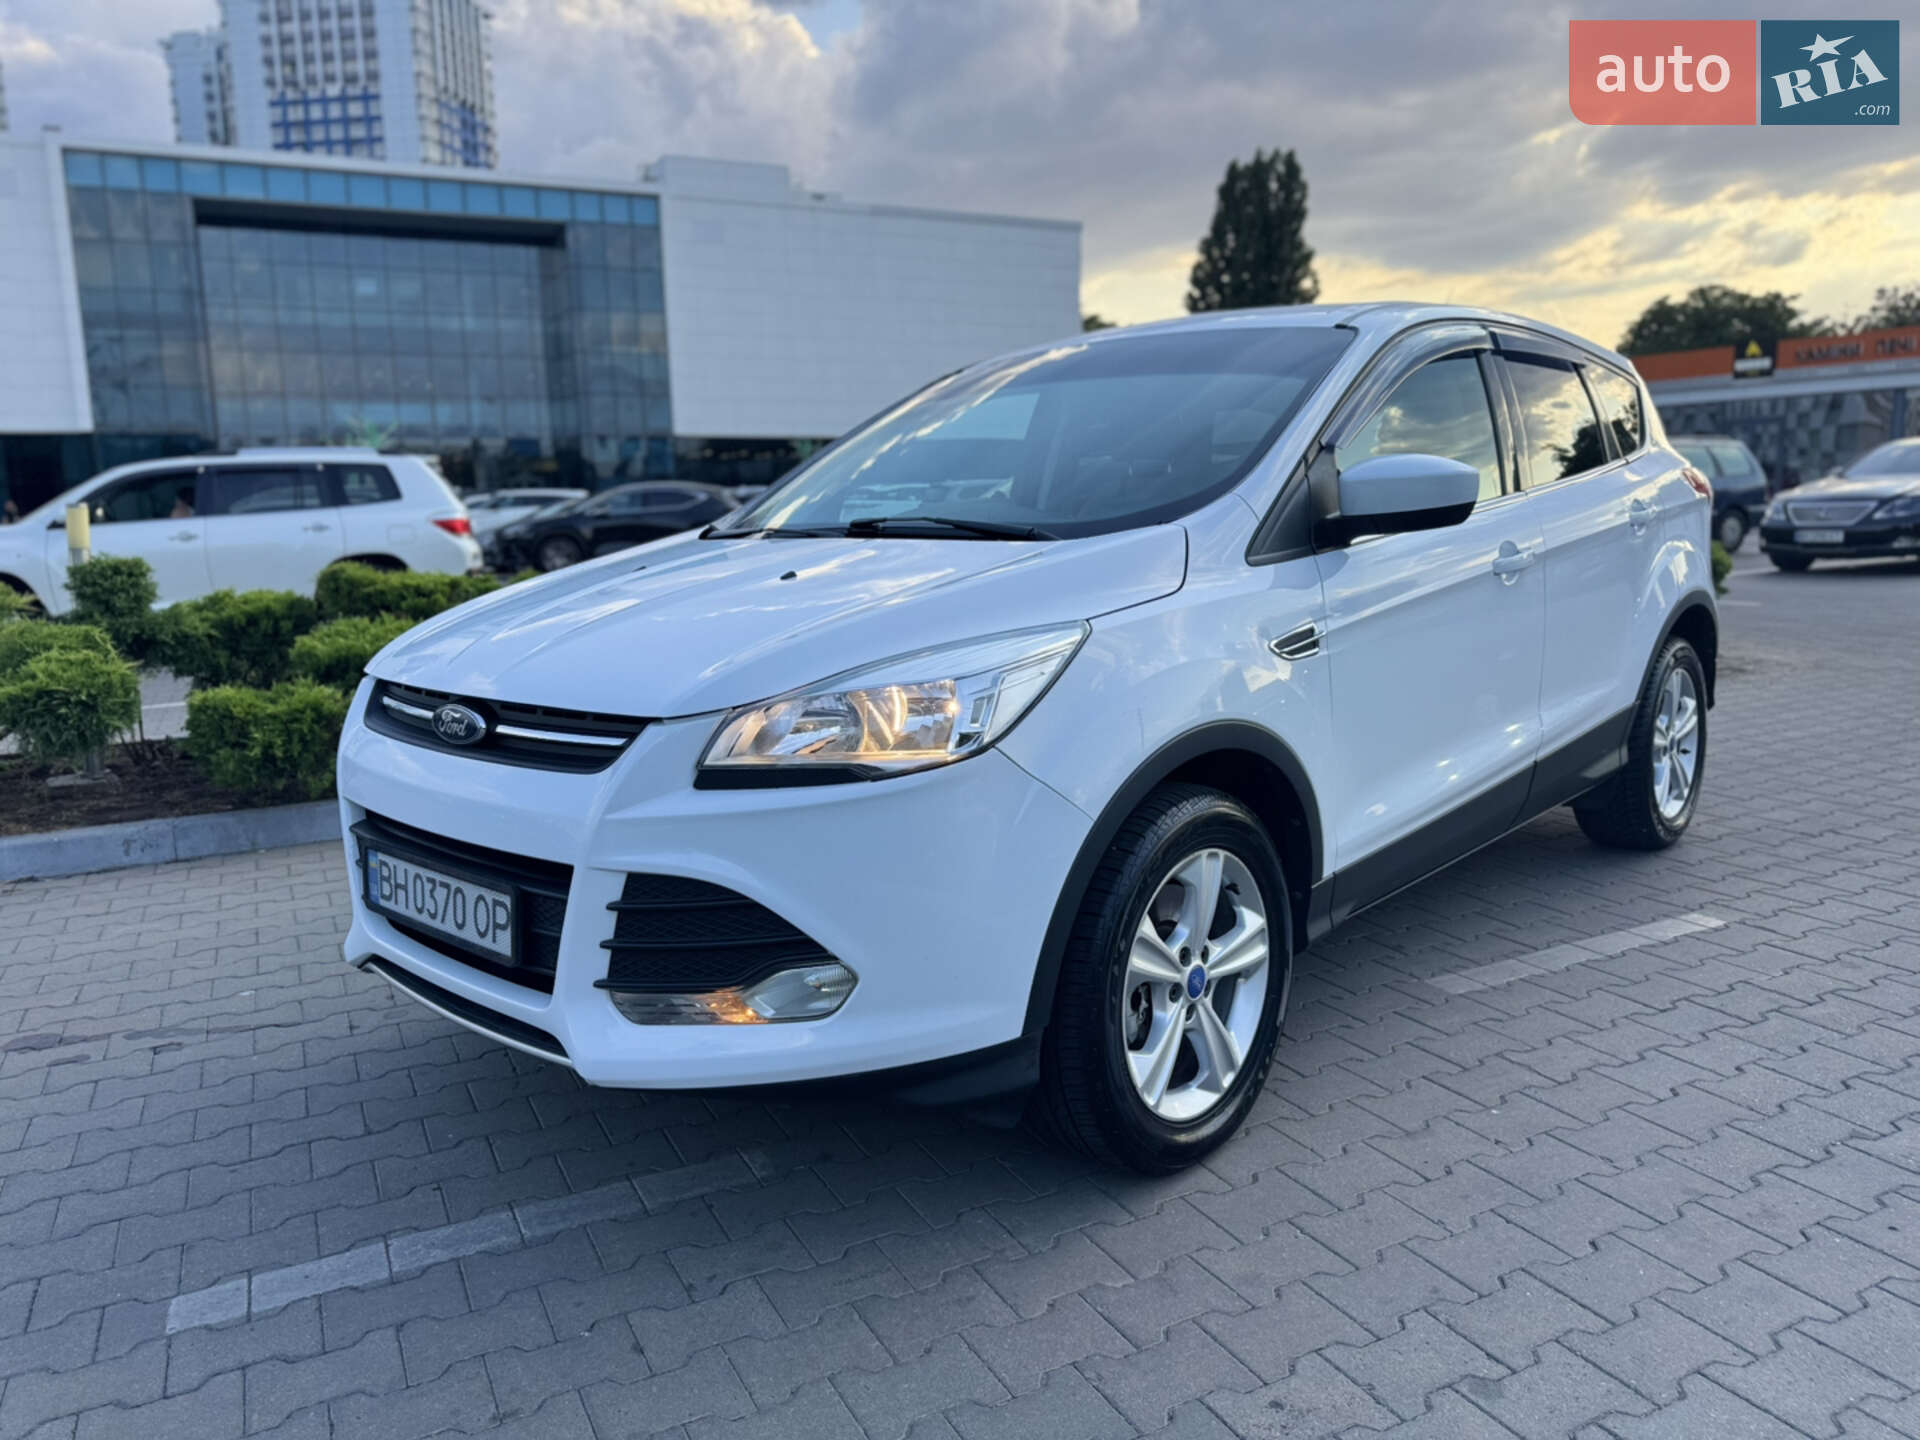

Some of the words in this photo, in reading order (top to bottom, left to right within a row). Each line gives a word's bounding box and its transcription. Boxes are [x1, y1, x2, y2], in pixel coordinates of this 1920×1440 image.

[438, 709, 469, 737] Ford
[379, 859, 409, 910] BH
[413, 871, 466, 931] 0370
[474, 894, 511, 944] OP
